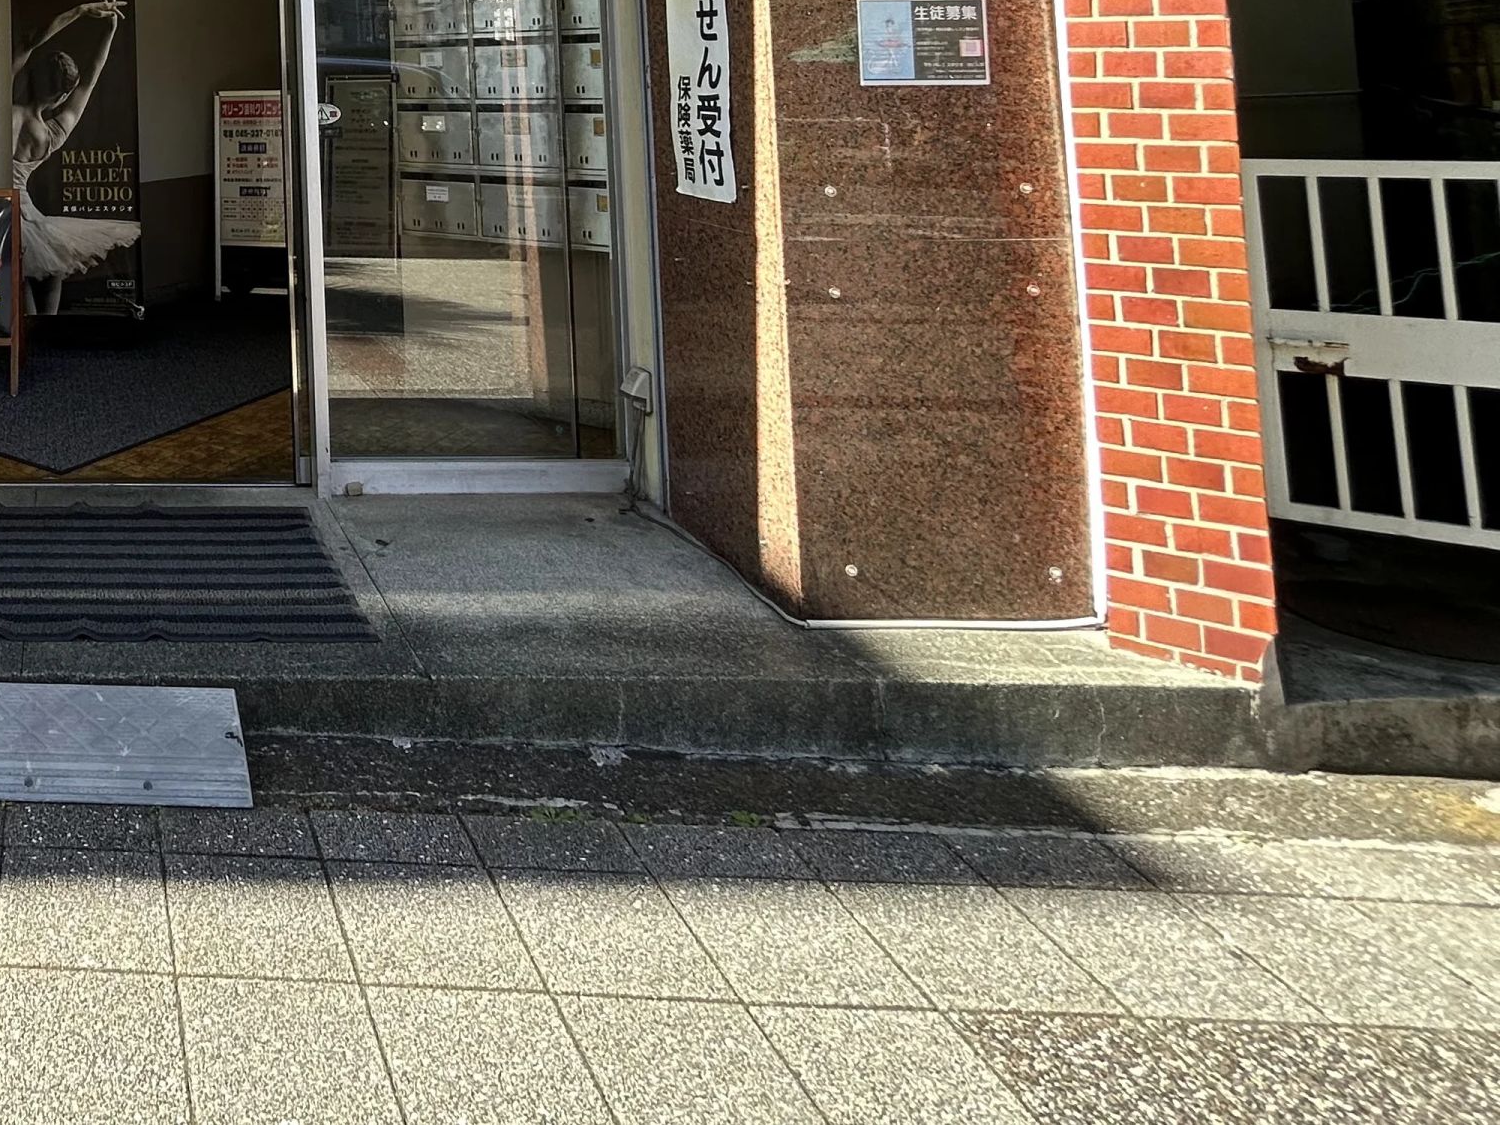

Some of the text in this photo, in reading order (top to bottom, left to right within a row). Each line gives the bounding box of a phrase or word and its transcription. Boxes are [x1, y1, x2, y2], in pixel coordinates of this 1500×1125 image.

[914, 5, 977, 21] 生徒募集
[677, 75, 696, 184] 保険薬局
[62, 150, 116, 165] MAHO
[62, 168, 132, 183] BALLET
[63, 186, 133, 202] STUDIO
